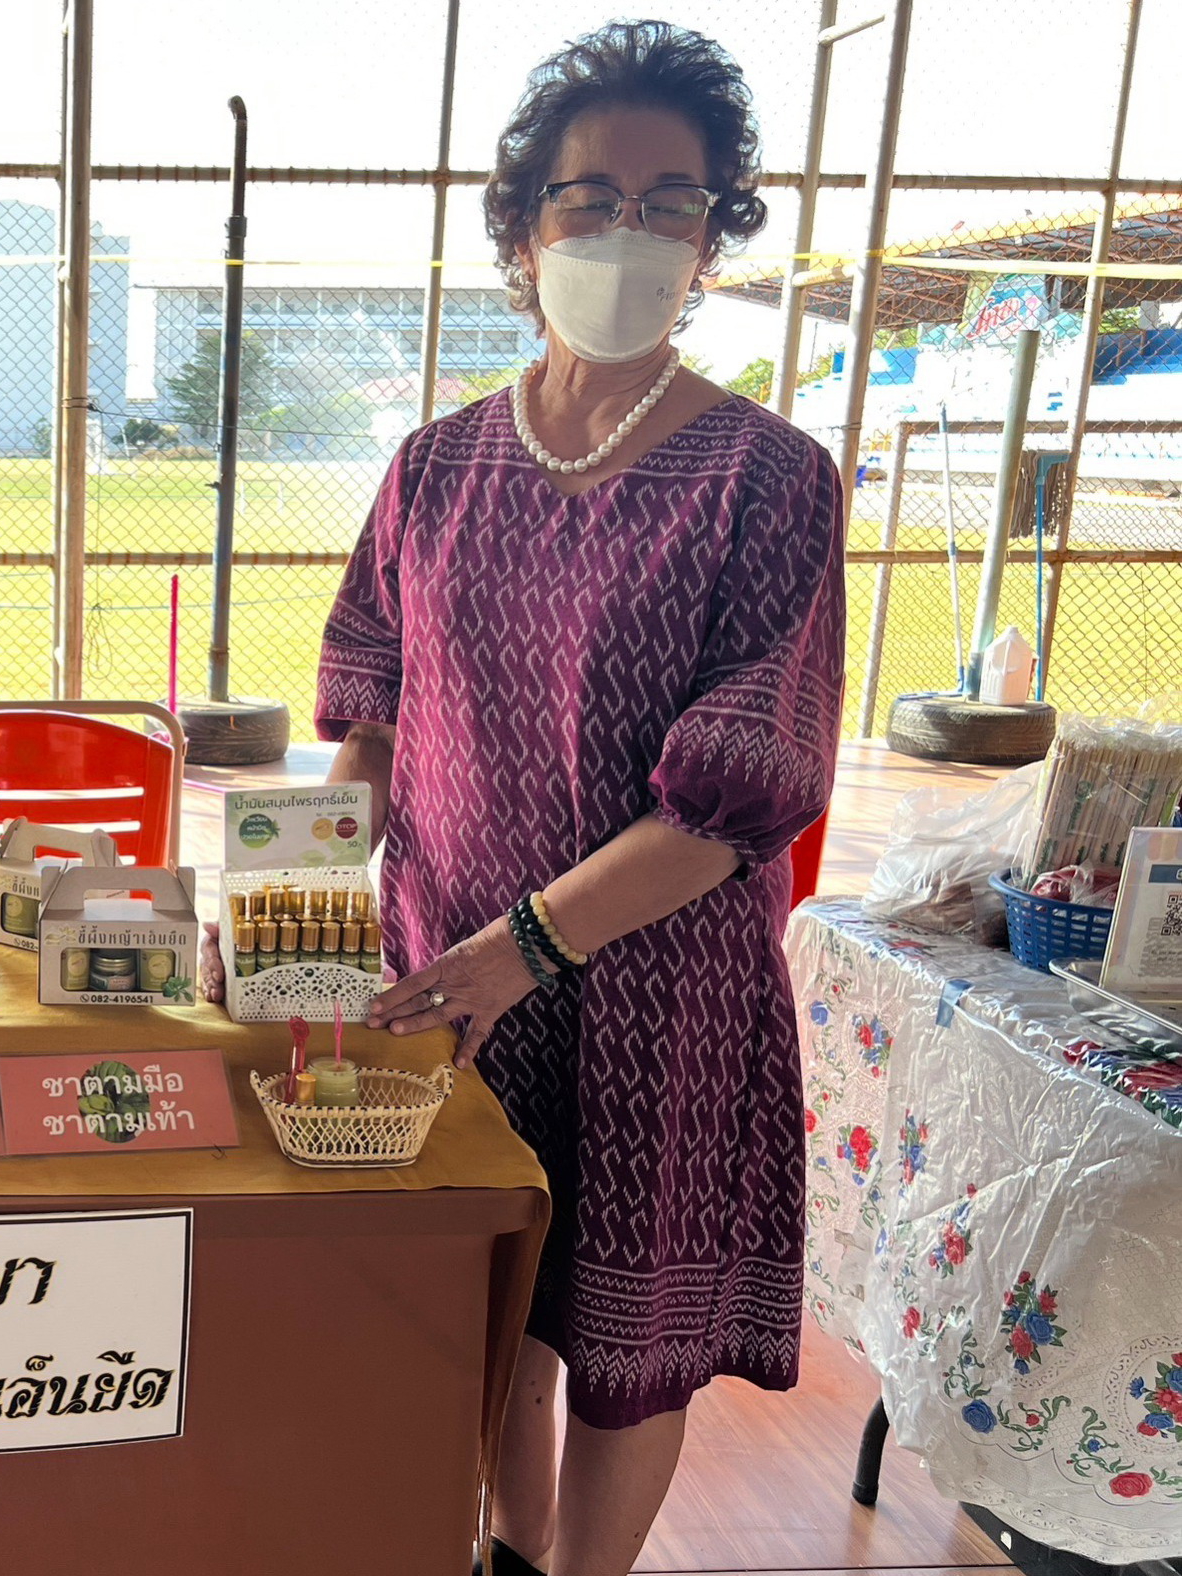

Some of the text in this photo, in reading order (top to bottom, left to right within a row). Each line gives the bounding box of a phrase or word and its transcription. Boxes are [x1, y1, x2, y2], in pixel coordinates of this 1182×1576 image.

[234, 791, 359, 811] น้ำมันสมุนไพรฤทธิ์เย็น
[77, 924, 188, 947] ขี้ผึ้งหญ้าเอ็นยืด
[90, 994, 155, 1004] 082-4196541
[41, 1064, 184, 1097] ชาตามมือ
[42, 1100, 195, 1137] ชาตามเท้า
